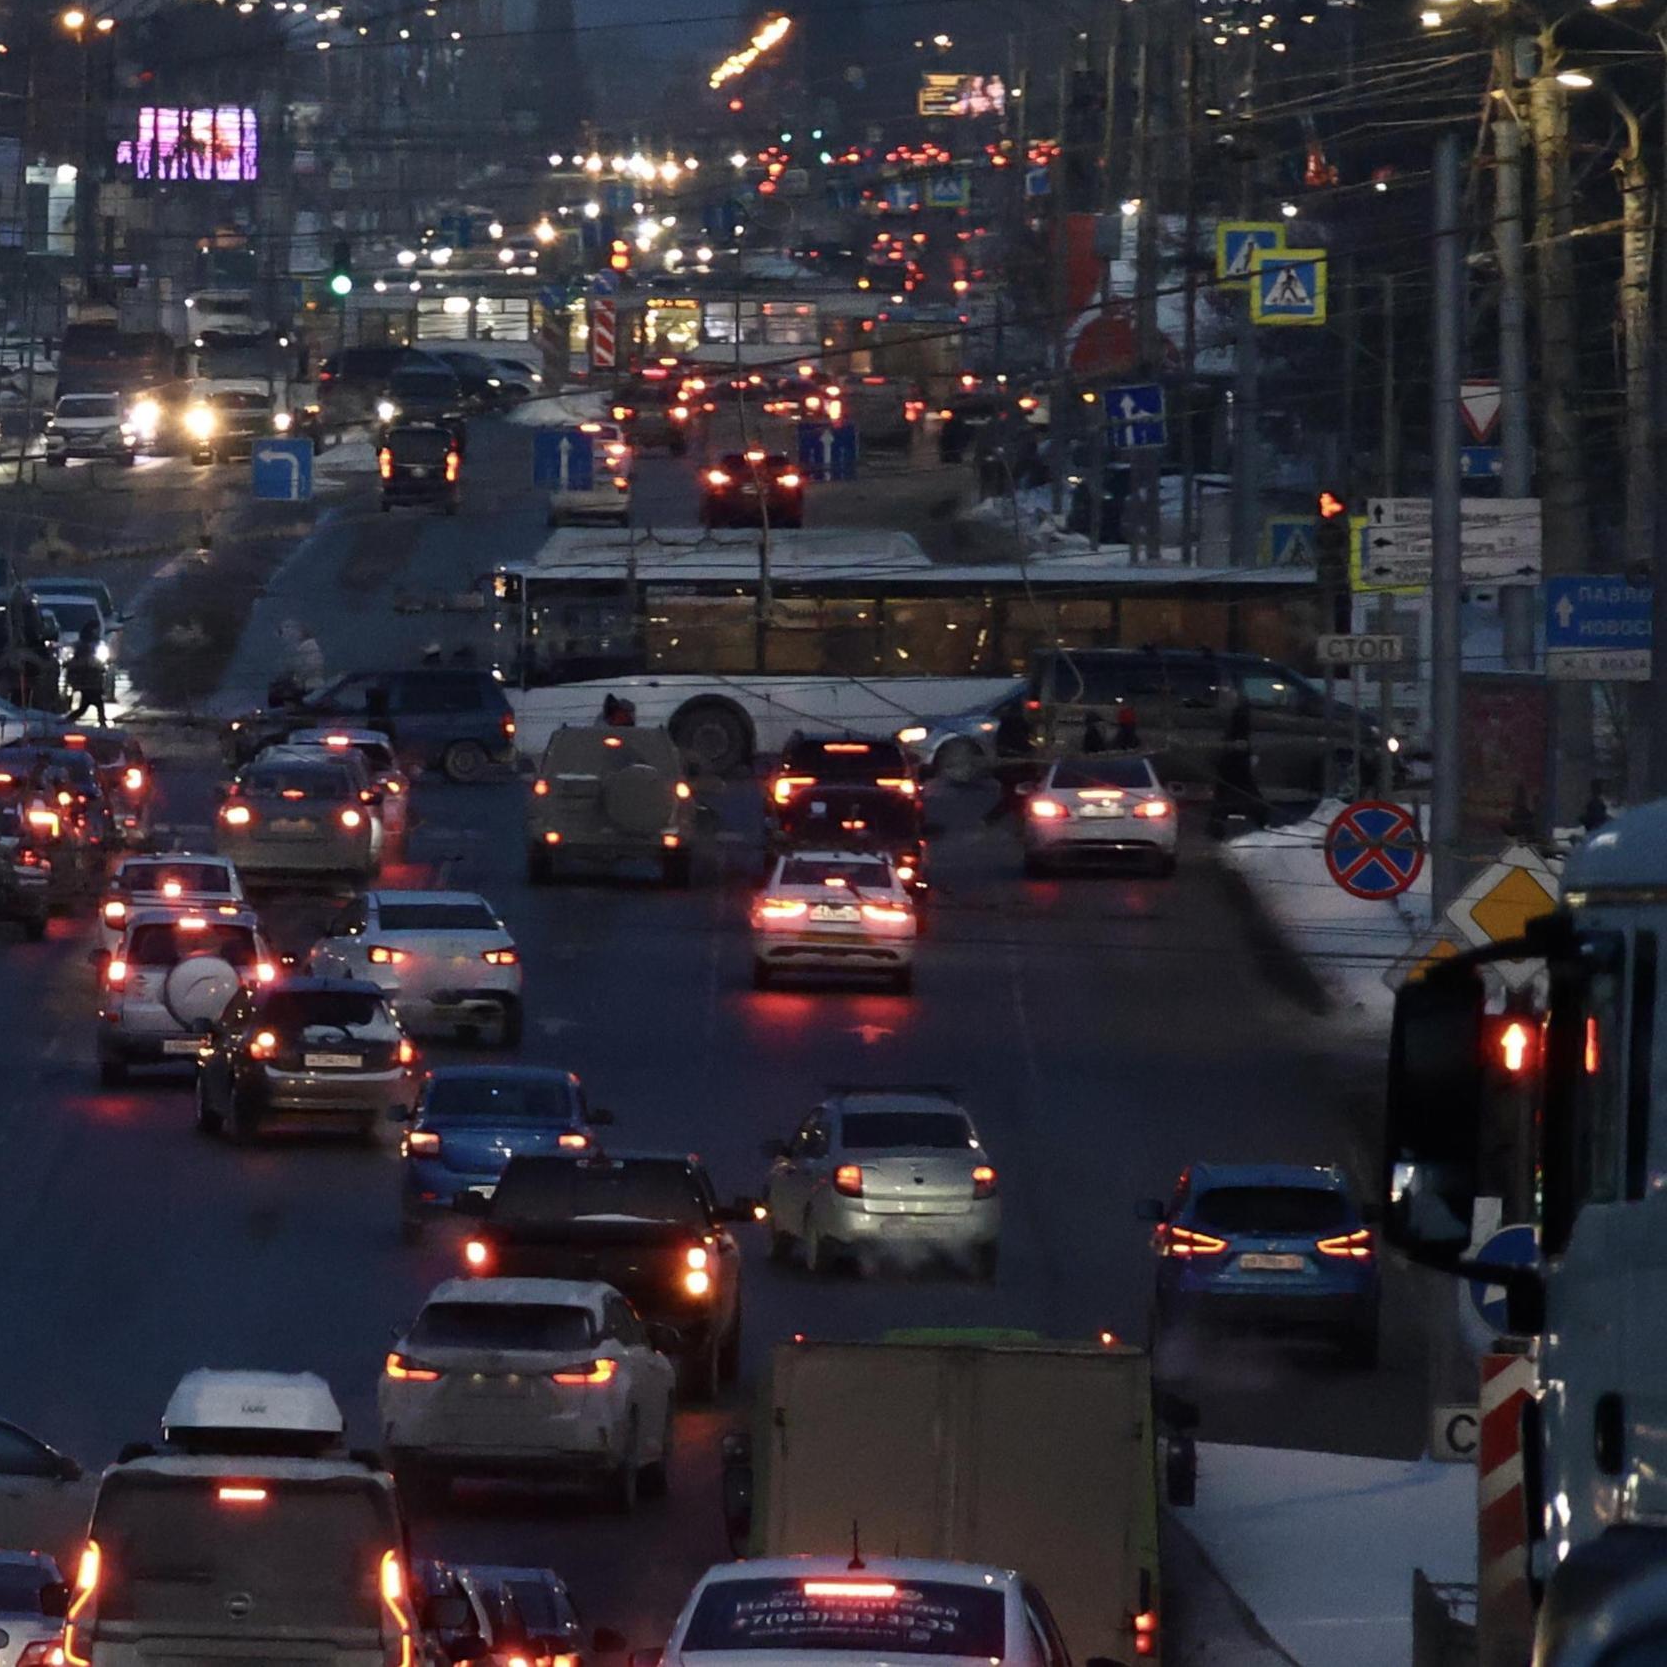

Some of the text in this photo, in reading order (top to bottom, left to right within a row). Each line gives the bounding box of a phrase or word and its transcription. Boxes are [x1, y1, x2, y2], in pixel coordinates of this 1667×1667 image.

[1578, 586, 1653, 604] ПАВЛО
[1578, 619, 1653, 636] НОВОС
[1327, 638, 1395, 659] СТОП
